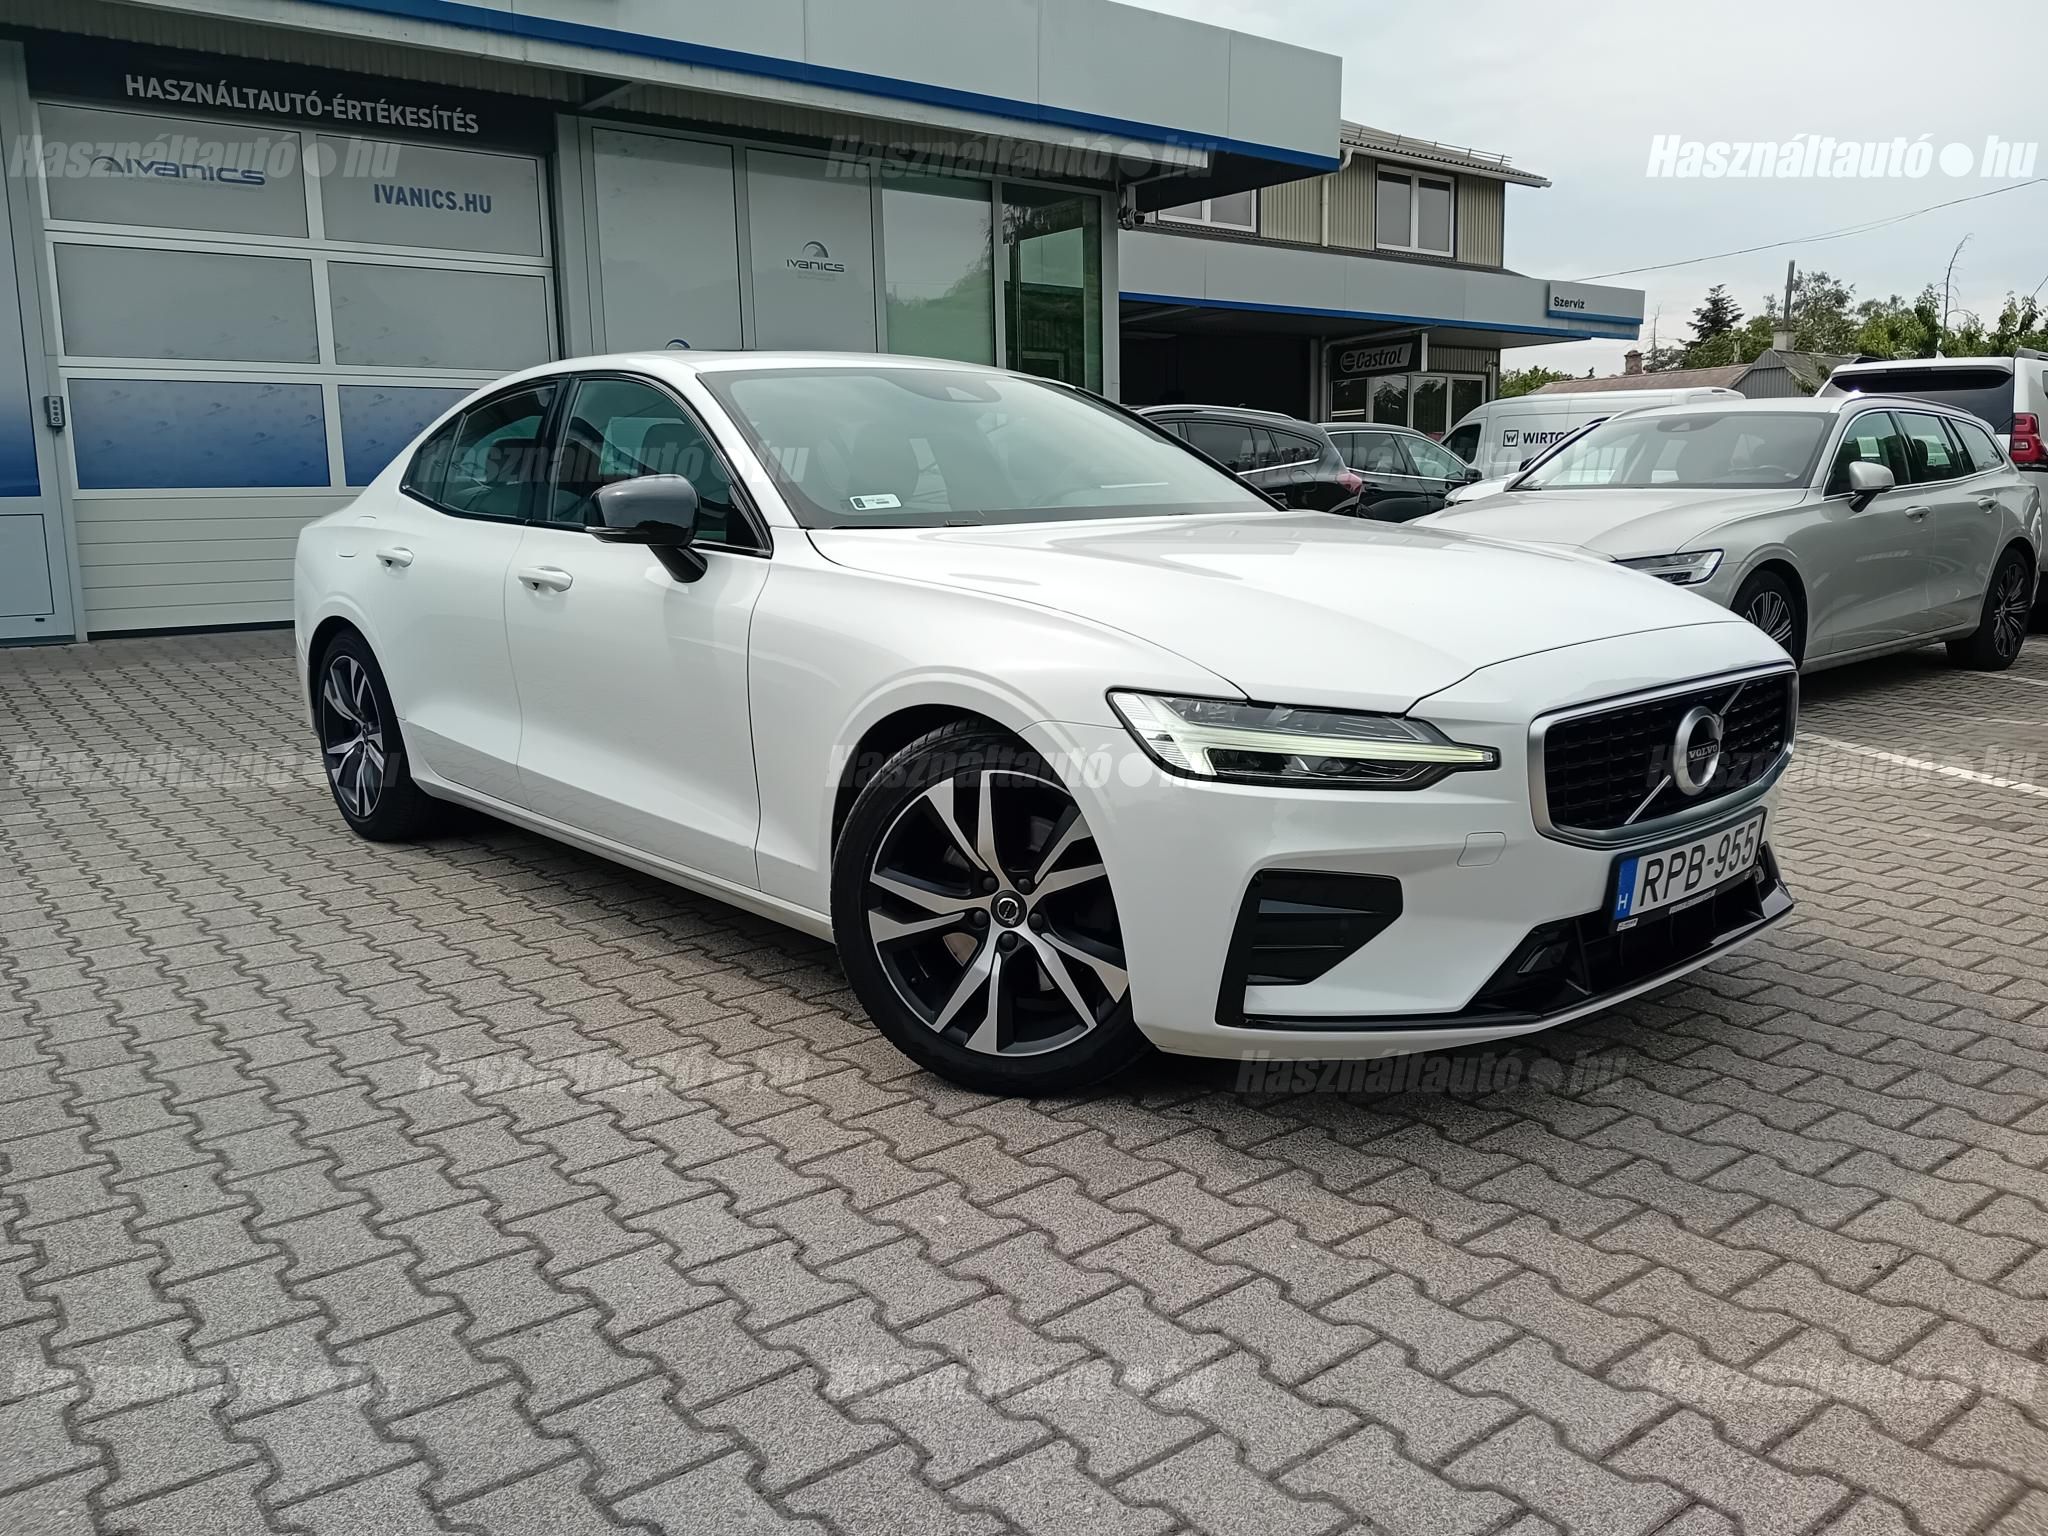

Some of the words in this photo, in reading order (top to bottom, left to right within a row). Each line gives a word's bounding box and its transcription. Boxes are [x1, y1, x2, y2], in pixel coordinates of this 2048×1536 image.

[124, 73, 480, 135] HASZNÁLTAUTÓ-ÉRTÉKESÍTÉS
[373, 183, 492, 214] IVANICS.HU
[1553, 296, 1585, 310] Szerviz
[1356, 346, 1403, 369] Castrol
[1688, 744, 1718, 759] VOLVO
[1617, 893, 1629, 911] H
[1639, 820, 1758, 907] RPB-955
